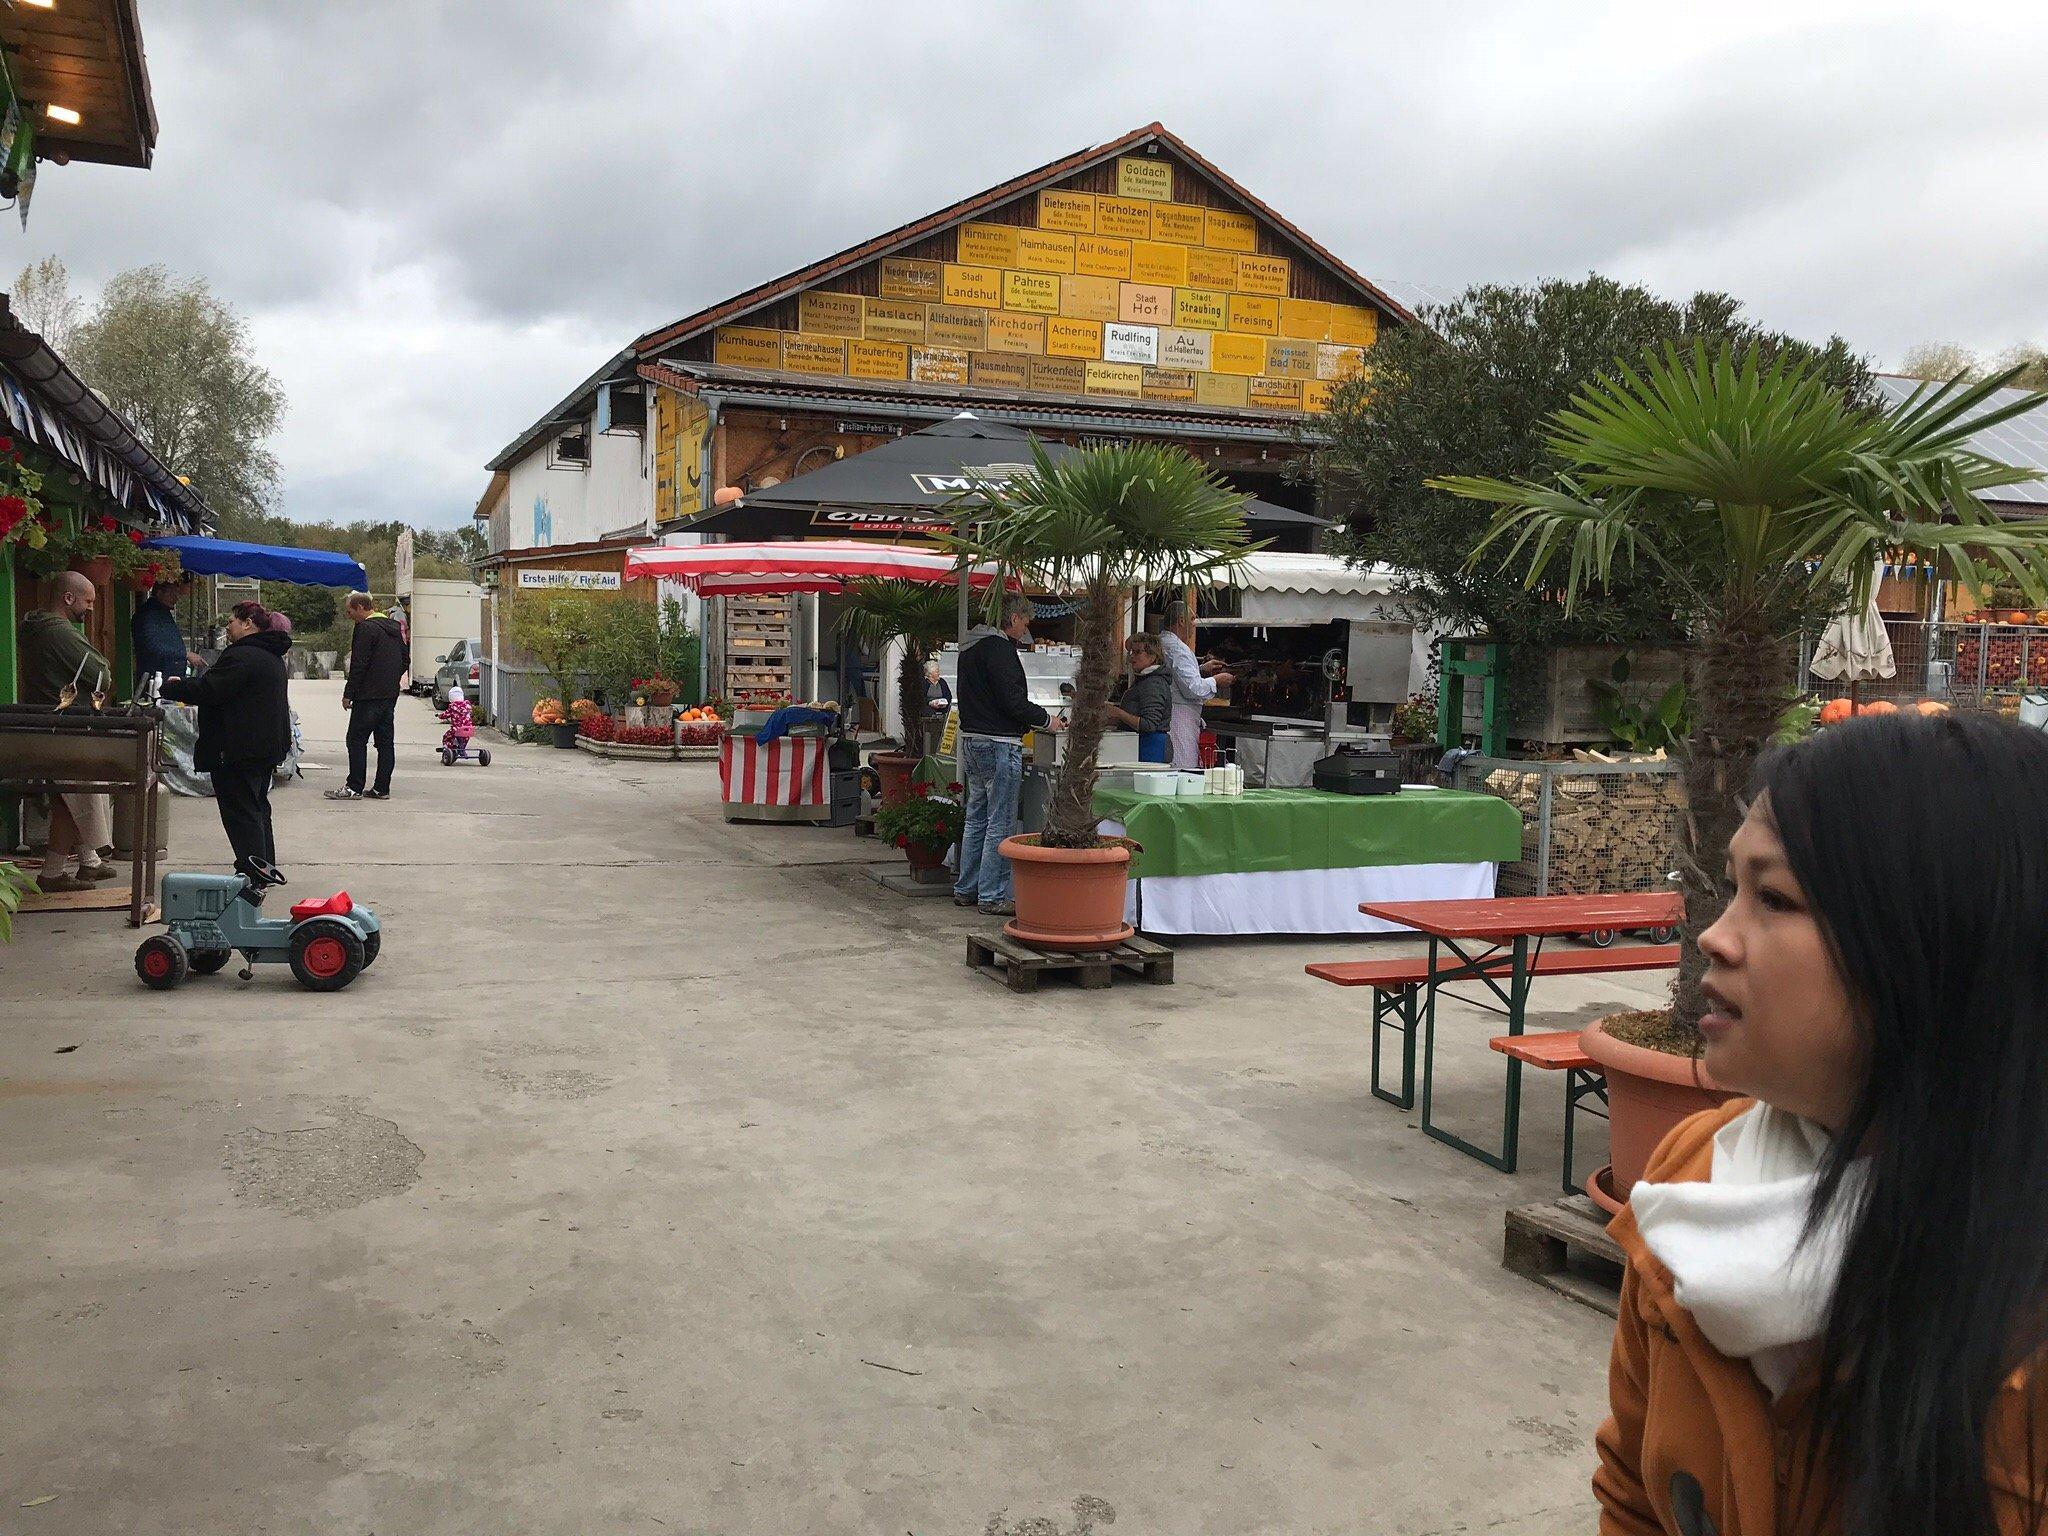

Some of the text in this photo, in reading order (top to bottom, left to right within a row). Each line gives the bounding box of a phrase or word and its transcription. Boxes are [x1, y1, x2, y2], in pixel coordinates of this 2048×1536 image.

[1126, 164, 1166, 178] Goldach
[1142, 188, 1163, 196] Freising
[1045, 198, 1091, 212] Dietersheim
[1098, 202, 1149, 217] Fürholzen
[1155, 209, 1201, 223] Giggenhausen
[1047, 218, 1088, 229] Kreis Freising
[1120, 226, 1144, 235] Freising
[1020, 238, 1074, 253] Haimhausen
[1079, 242, 1130, 258] Alf (Mosel)
[1045, 256, 1066, 265] Dachau
[1241, 261, 1286, 274] Inkofen
[961, 272, 983, 282] Stadt
[1013, 275, 1051, 288] Pahres
[946, 285, 997, 300] Landshut
[1135, 293, 1157, 304] Stadt
[1191, 292, 1212, 302] Stadt
[808, 298, 856, 315] Manzing
[1132, 302, 1159, 315] Hof
[1180, 301, 1221, 318] Straubing
[868, 307, 922, 321] Haslach
[823, 322, 860, 332] Deggendorf
[989, 316, 1044, 332] Kirchdorf
[1233, 313, 1273, 329] Freising
[872, 325, 917, 336] Kreis Freising
[934, 331, 978, 343] Kreis Freising
[1051, 324, 1098, 340] Achering
[718, 333, 778, 349] Kumhausen
[1004, 339, 1029, 349] Freising
[1111, 330, 1152, 346] Rudlfing
[1176, 335, 1195, 346] Au
[852, 344, 904, 361] Trauterfing
[1051, 341, 1097, 353] Stadt Freising
[744, 355, 770, 364] Landshut
[1126, 350, 1151, 359] Freising
[807, 364, 840, 373] Landshut
[856, 358, 871, 366] Stadt
[974, 359, 1026, 377] Hausmehring
[1180, 358, 1204, 366] Freising
[1270, 357, 1289, 368] Bad
[1292, 358, 1311, 370] Tölz
[1031, 362, 1083, 378] Türkenfeld
[1086, 368, 1140, 381] Feldkirchen
[1051, 383, 1080, 391] Landshut
[1252, 378, 1292, 390] Landshut
[836, 421, 902, 433] Cristian-Pabst-We
[523, 574, 546, 583] Erste
[580, 575, 600, 586] First
[601, 576, 616, 585] Aid
